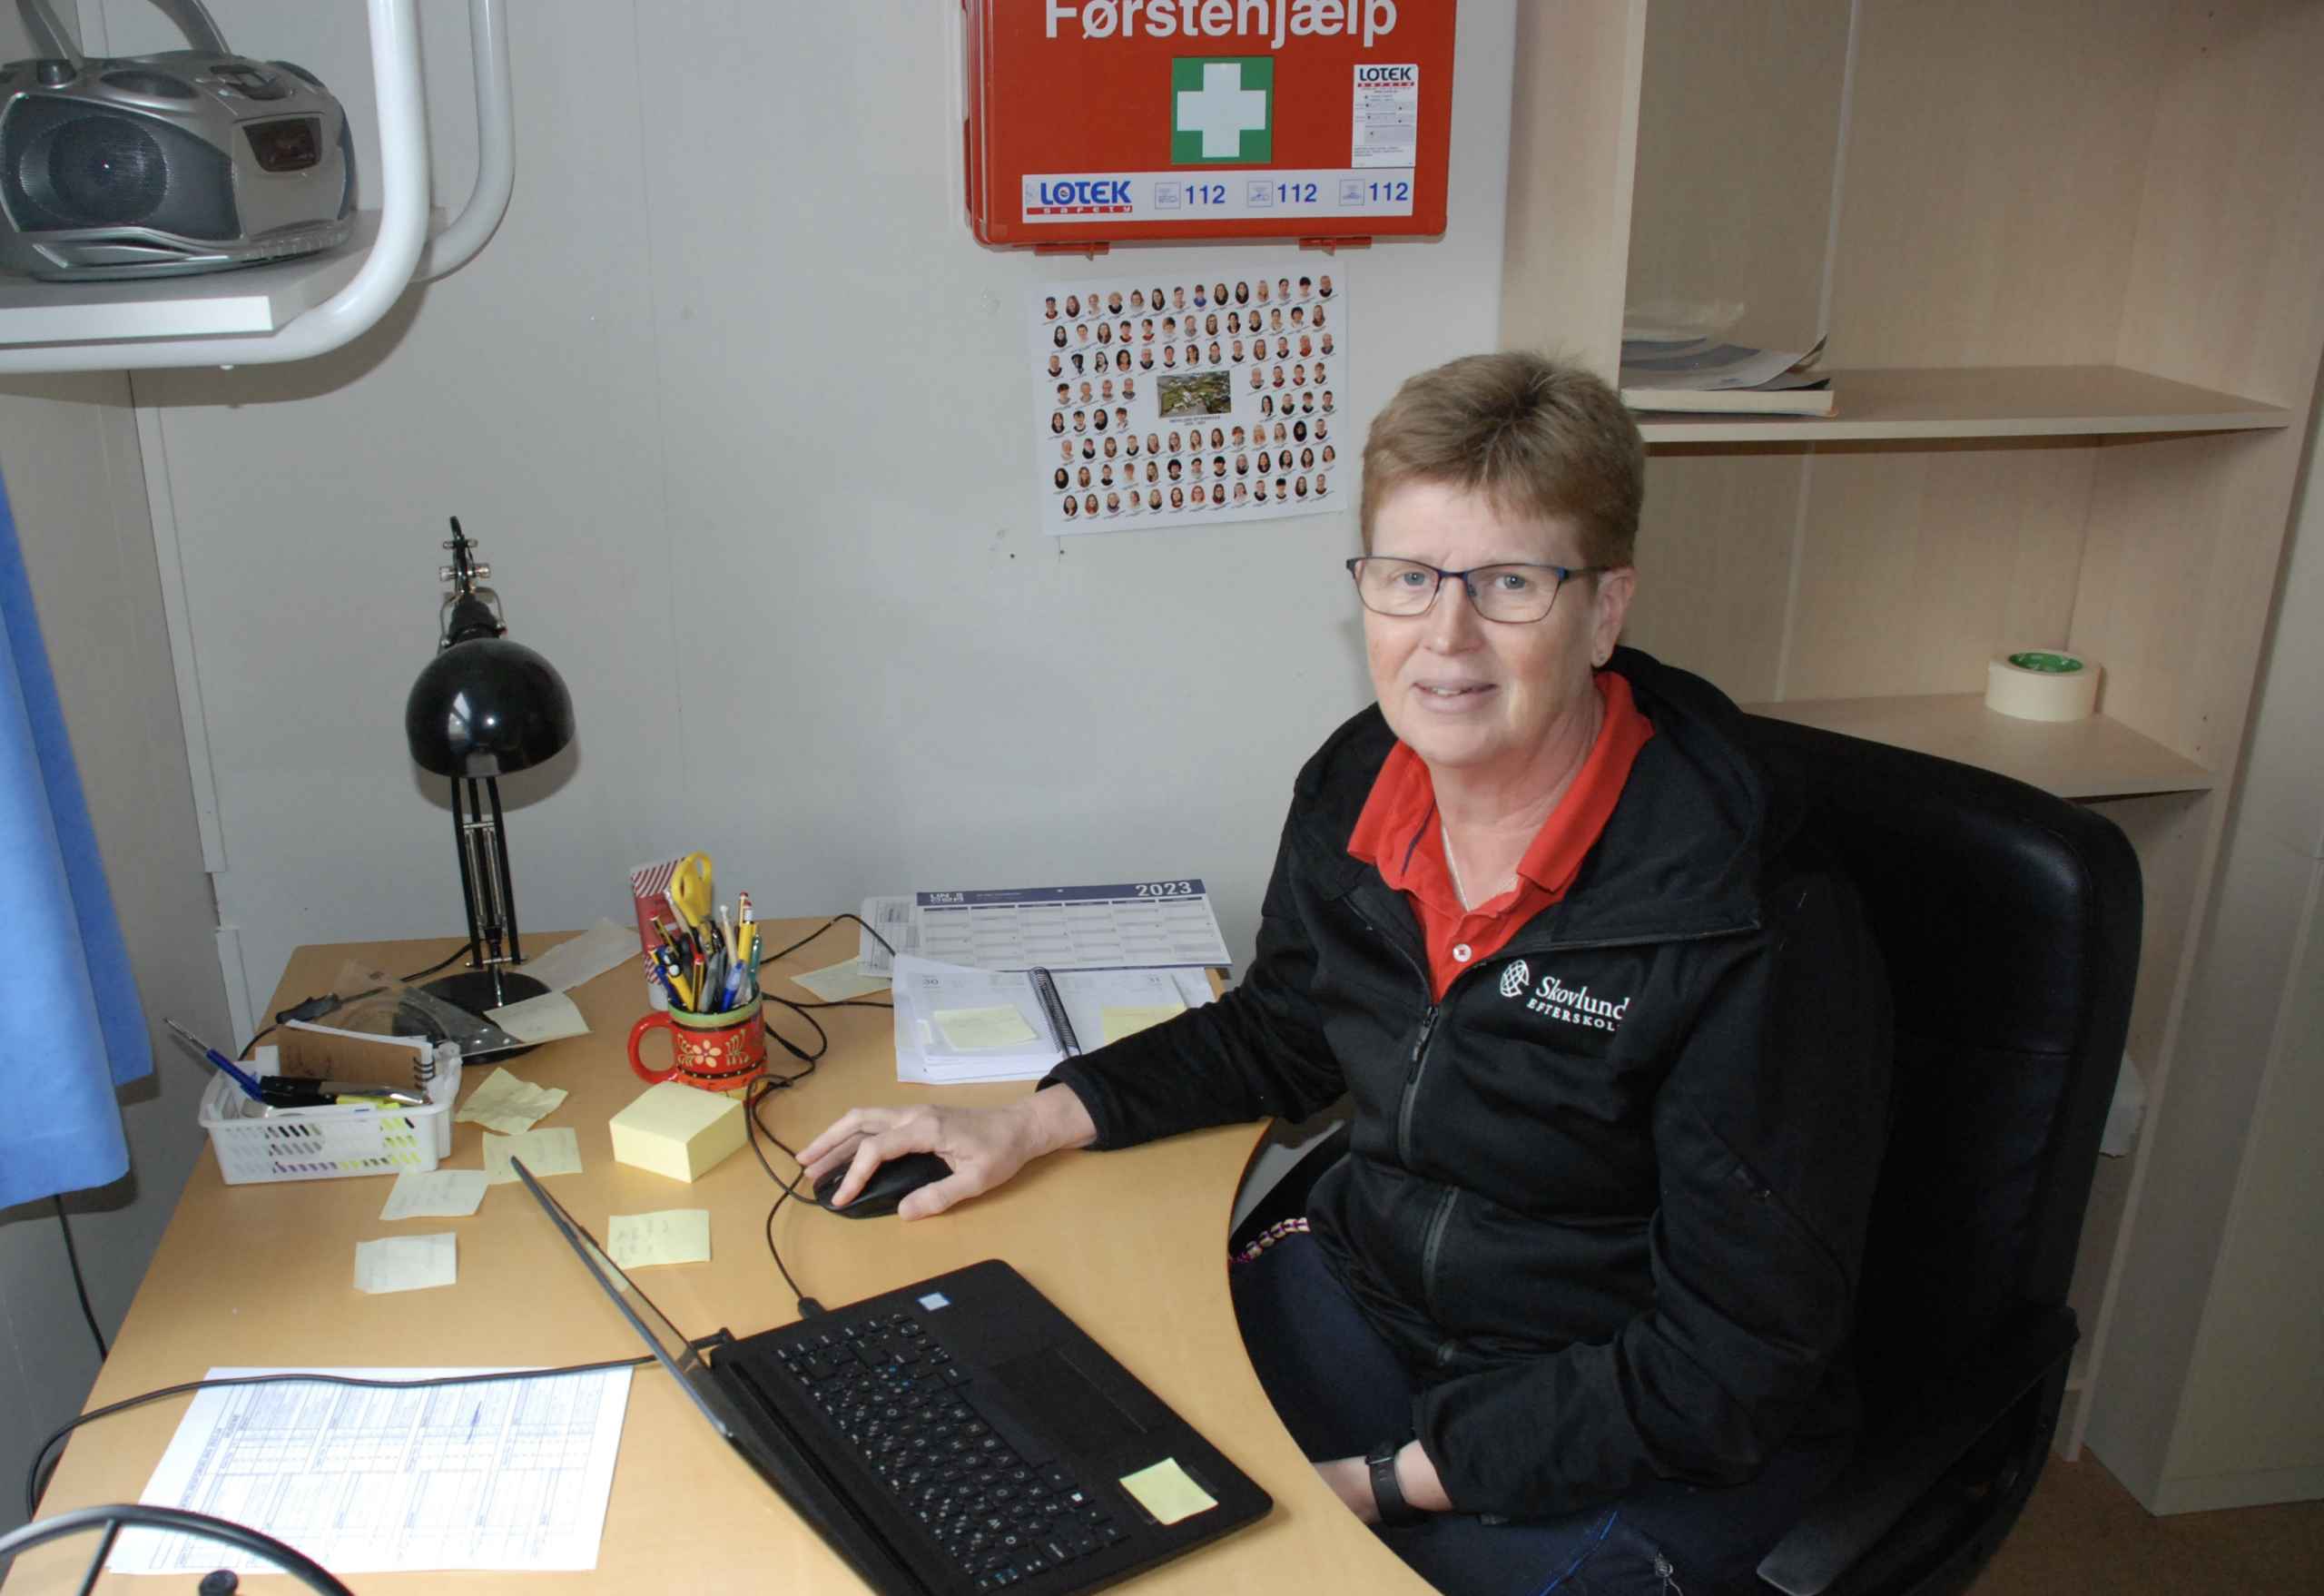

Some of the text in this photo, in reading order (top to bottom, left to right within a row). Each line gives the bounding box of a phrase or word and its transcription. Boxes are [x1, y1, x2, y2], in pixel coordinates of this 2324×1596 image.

[1360, 67, 1412, 81] LOTEK
[1039, 181, 1132, 204] LOTEK
[1186, 182, 1408, 204] 112 112 112
[1135, 882, 1192, 896] 2023
[1535, 976, 1630, 1020] Skovlund
[1526, 998, 1620, 1032] EFTERSKOL
